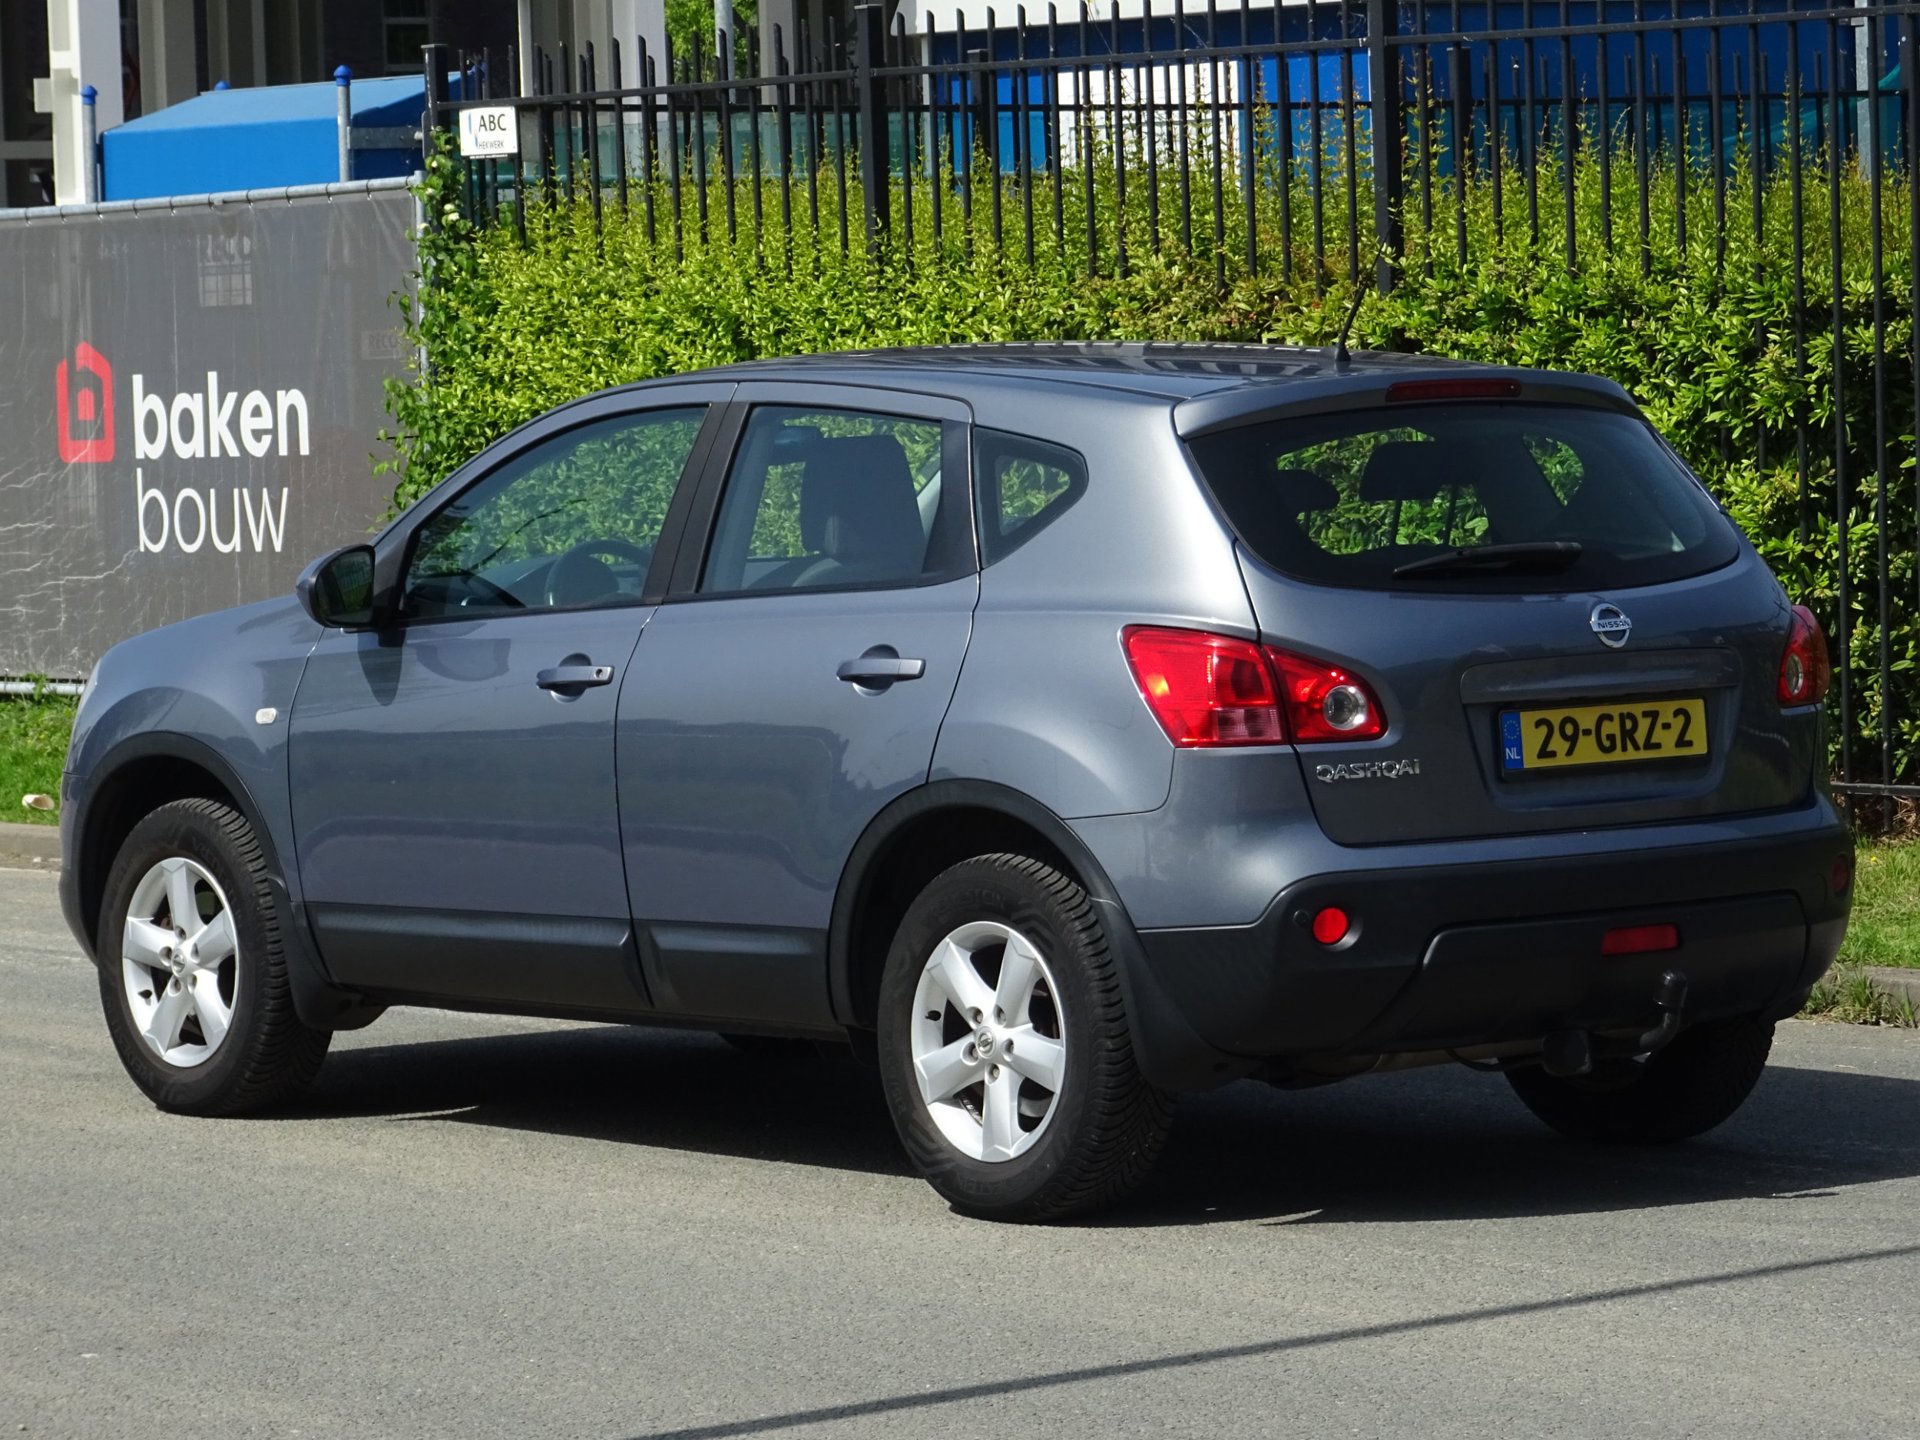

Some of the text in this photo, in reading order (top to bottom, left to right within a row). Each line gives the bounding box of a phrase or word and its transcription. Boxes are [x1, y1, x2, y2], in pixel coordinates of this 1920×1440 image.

[479, 113, 507, 132] ABC
[479, 140, 505, 150] HEKWERK
[132, 371, 310, 460] baken
[136, 467, 288, 553] bouw
[1597, 619, 1630, 629] NISSAN
[1534, 707, 1694, 760] 29-GRZ-2
[1505, 747, 1521, 760] NL
